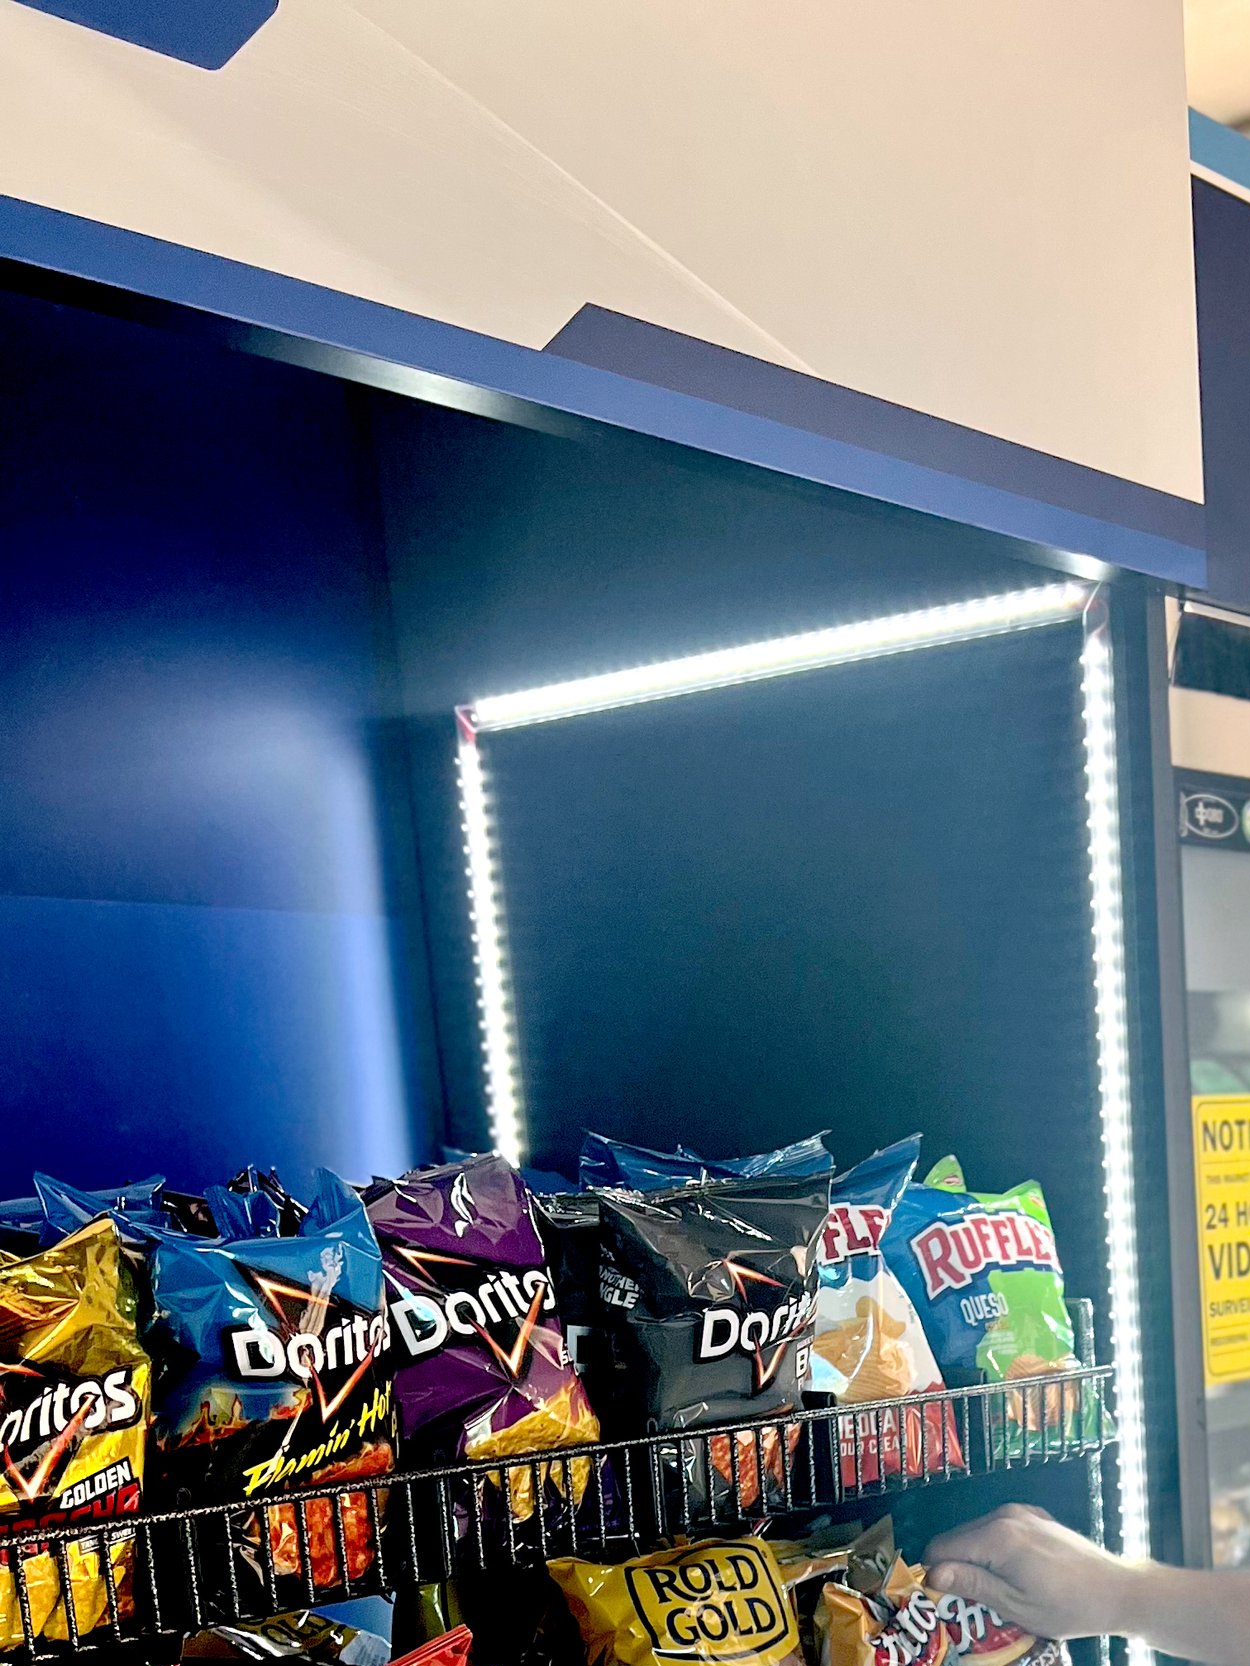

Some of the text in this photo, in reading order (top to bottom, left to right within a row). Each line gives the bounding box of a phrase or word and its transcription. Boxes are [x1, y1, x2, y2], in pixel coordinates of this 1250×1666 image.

[1206, 1202, 1229, 1230] 24
[960, 1294, 1009, 1326] QUESO
[59, 1460, 132, 1510] GOLDEN
[643, 1554, 759, 1605] ROLD
[666, 1596, 776, 1646] GOLD
